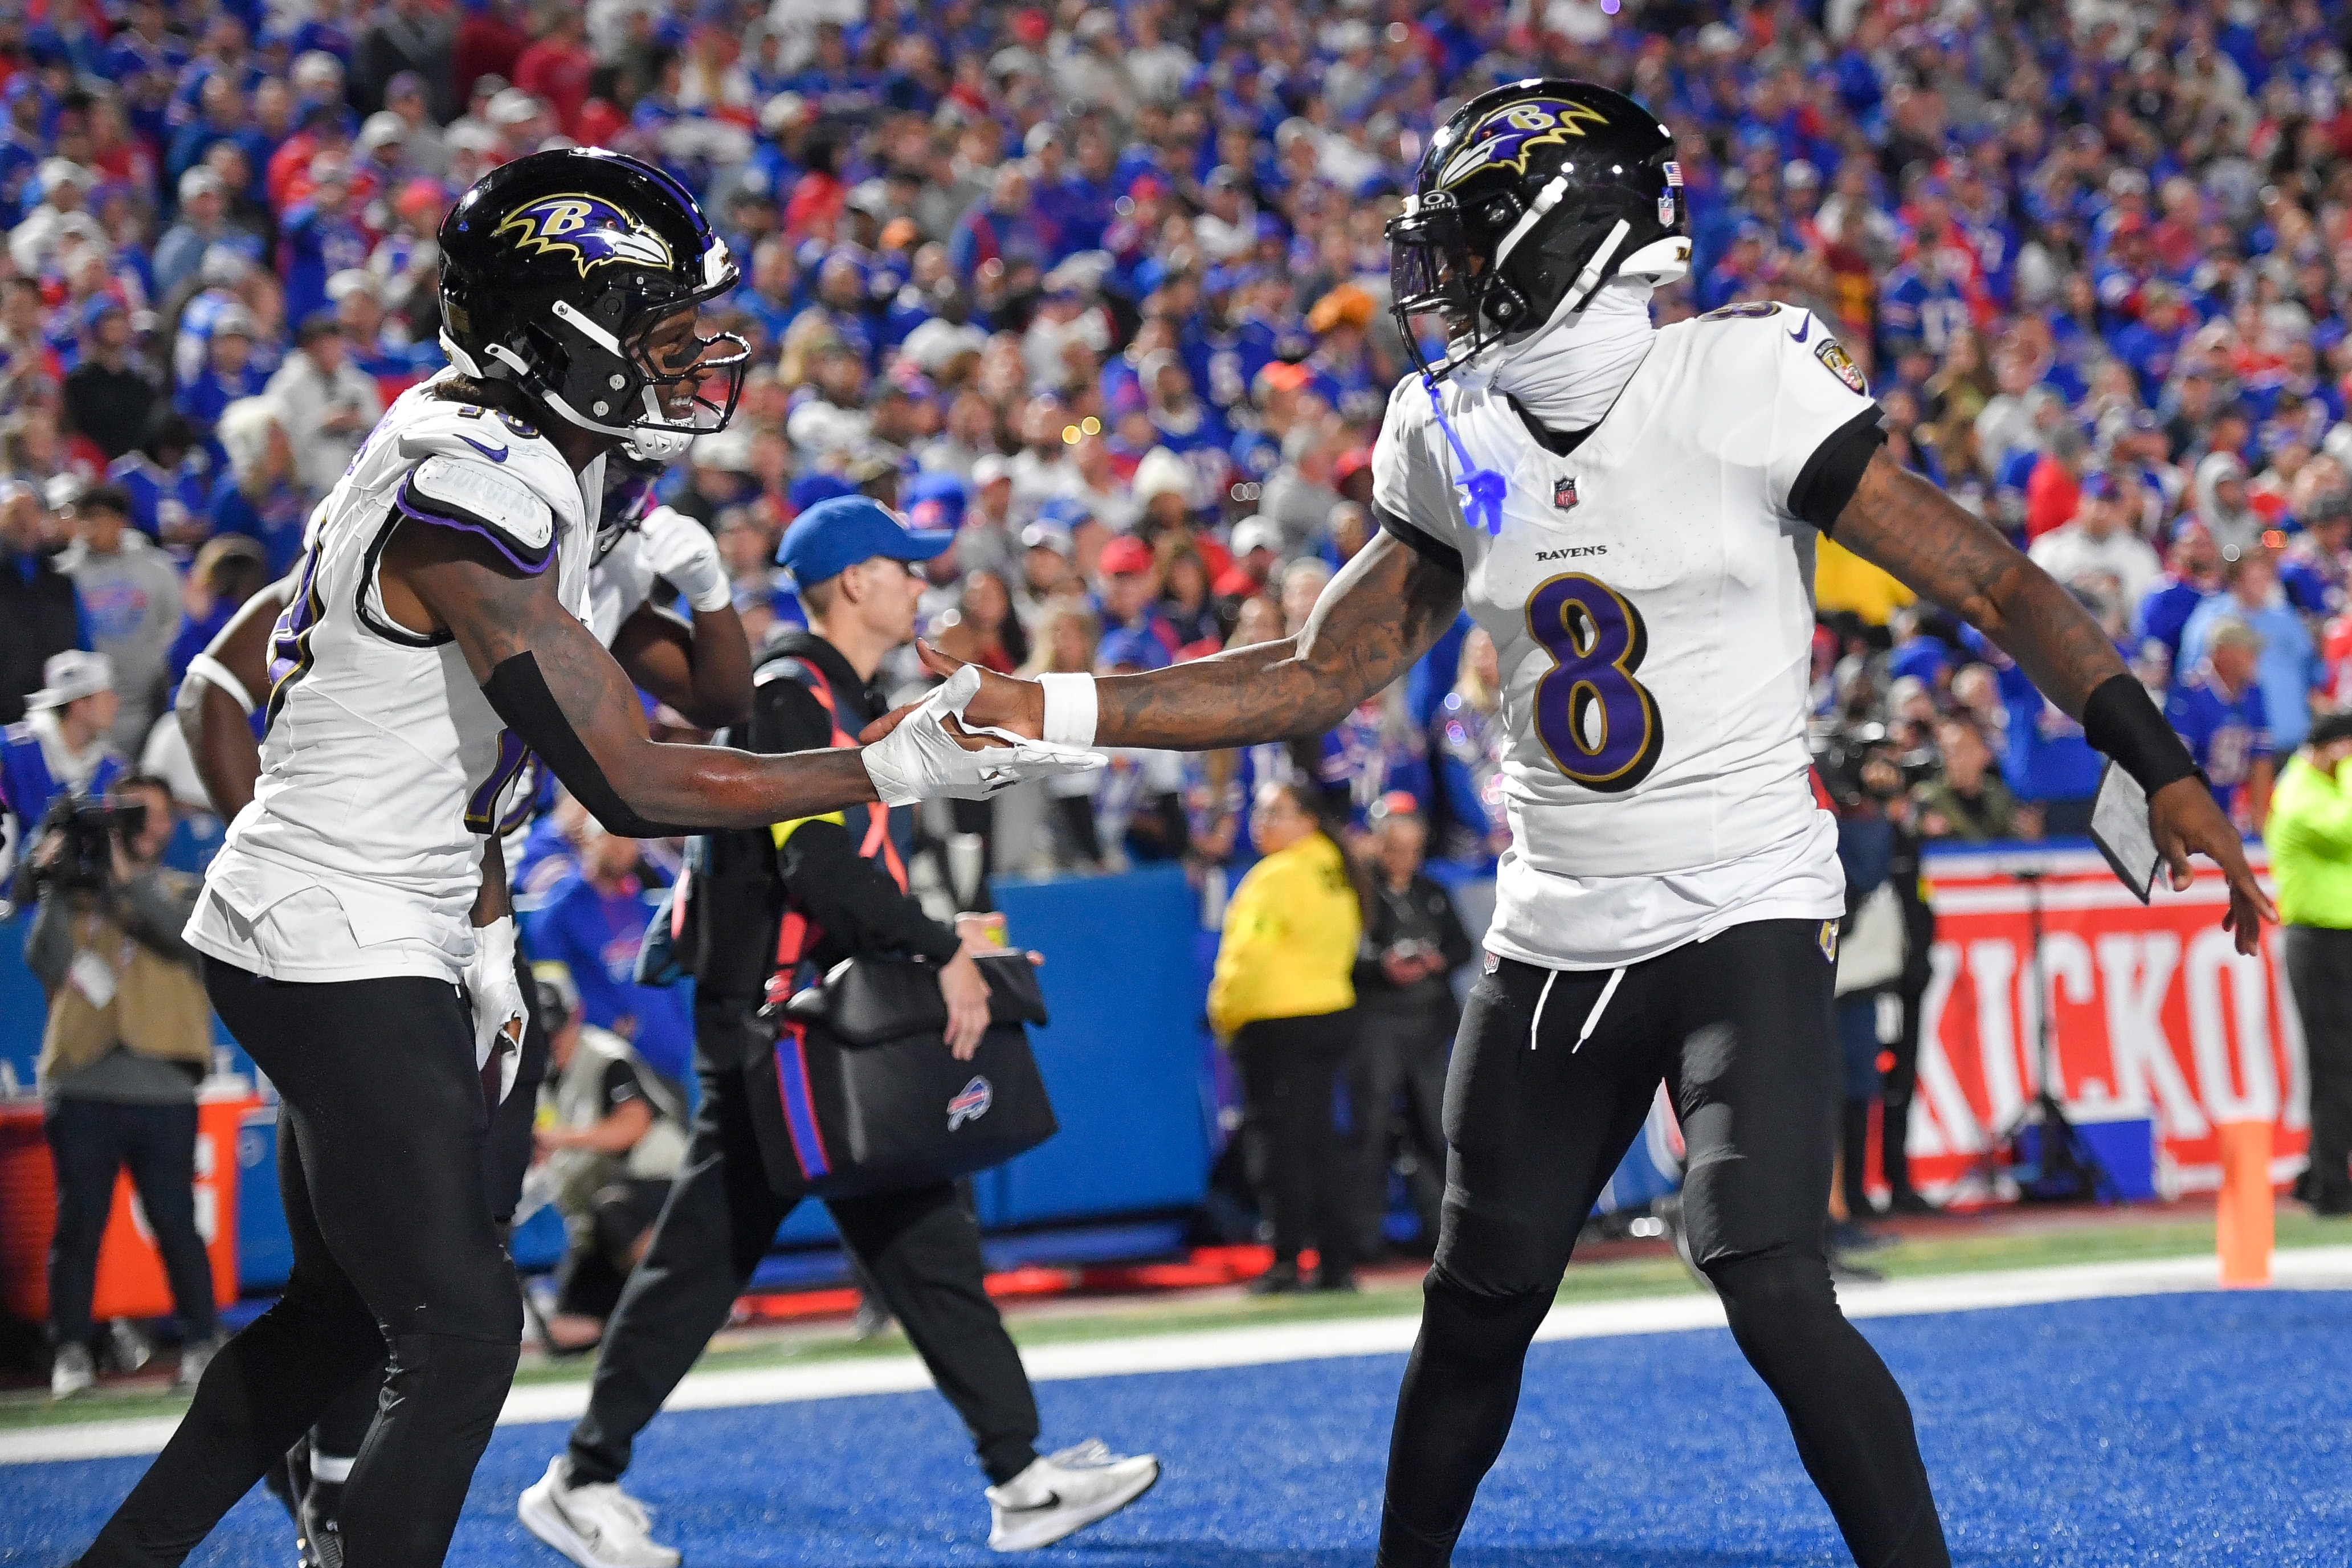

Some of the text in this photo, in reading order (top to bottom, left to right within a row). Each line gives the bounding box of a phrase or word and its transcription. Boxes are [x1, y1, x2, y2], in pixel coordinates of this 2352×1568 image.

[1555, 488, 1578, 507] NFL
[1535, 545, 1608, 562] RAVENS
[1525, 571, 1664, 793] 8
